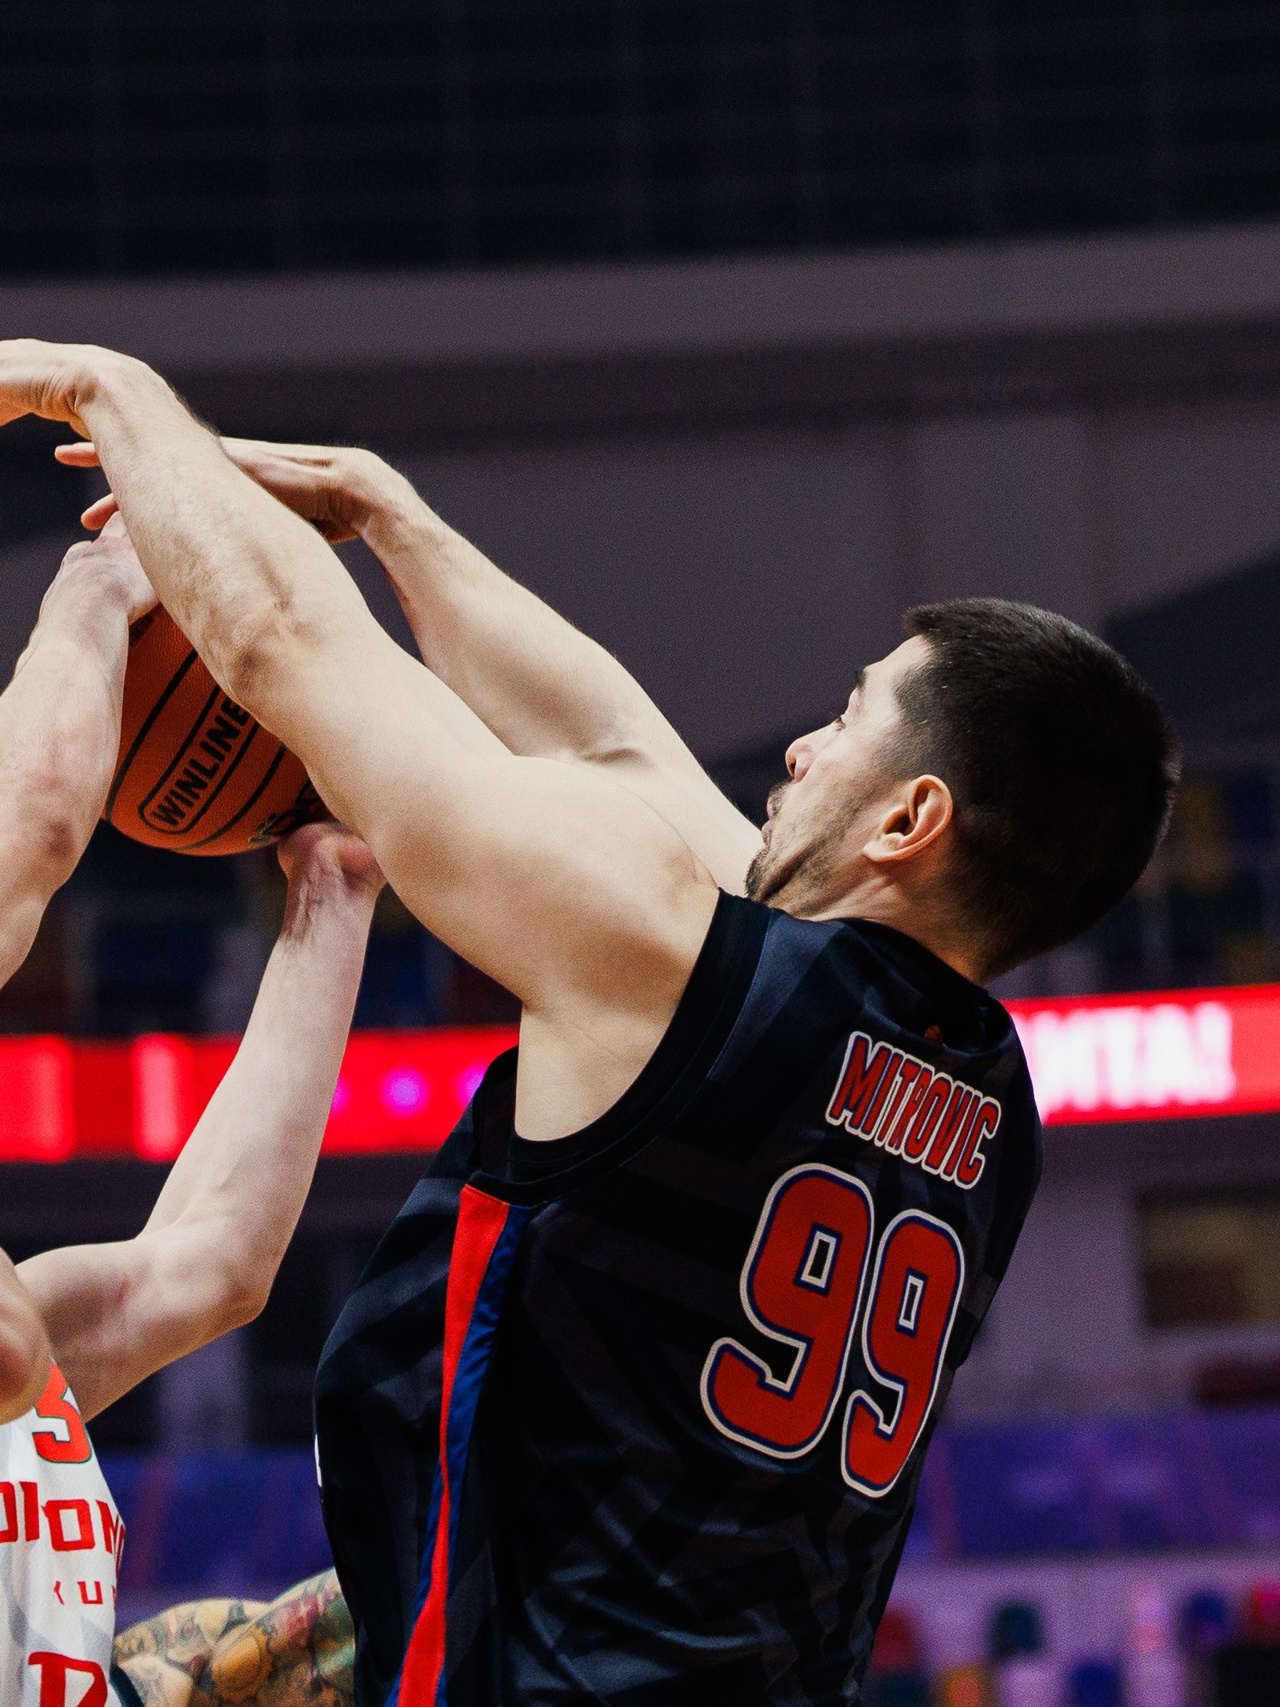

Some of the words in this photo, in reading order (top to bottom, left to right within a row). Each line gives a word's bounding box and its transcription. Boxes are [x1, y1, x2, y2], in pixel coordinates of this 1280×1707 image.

[150, 696, 251, 826] WINLINE
[825, 1031, 1001, 1190] MITROVIC
[700, 1163, 964, 1497] 99
